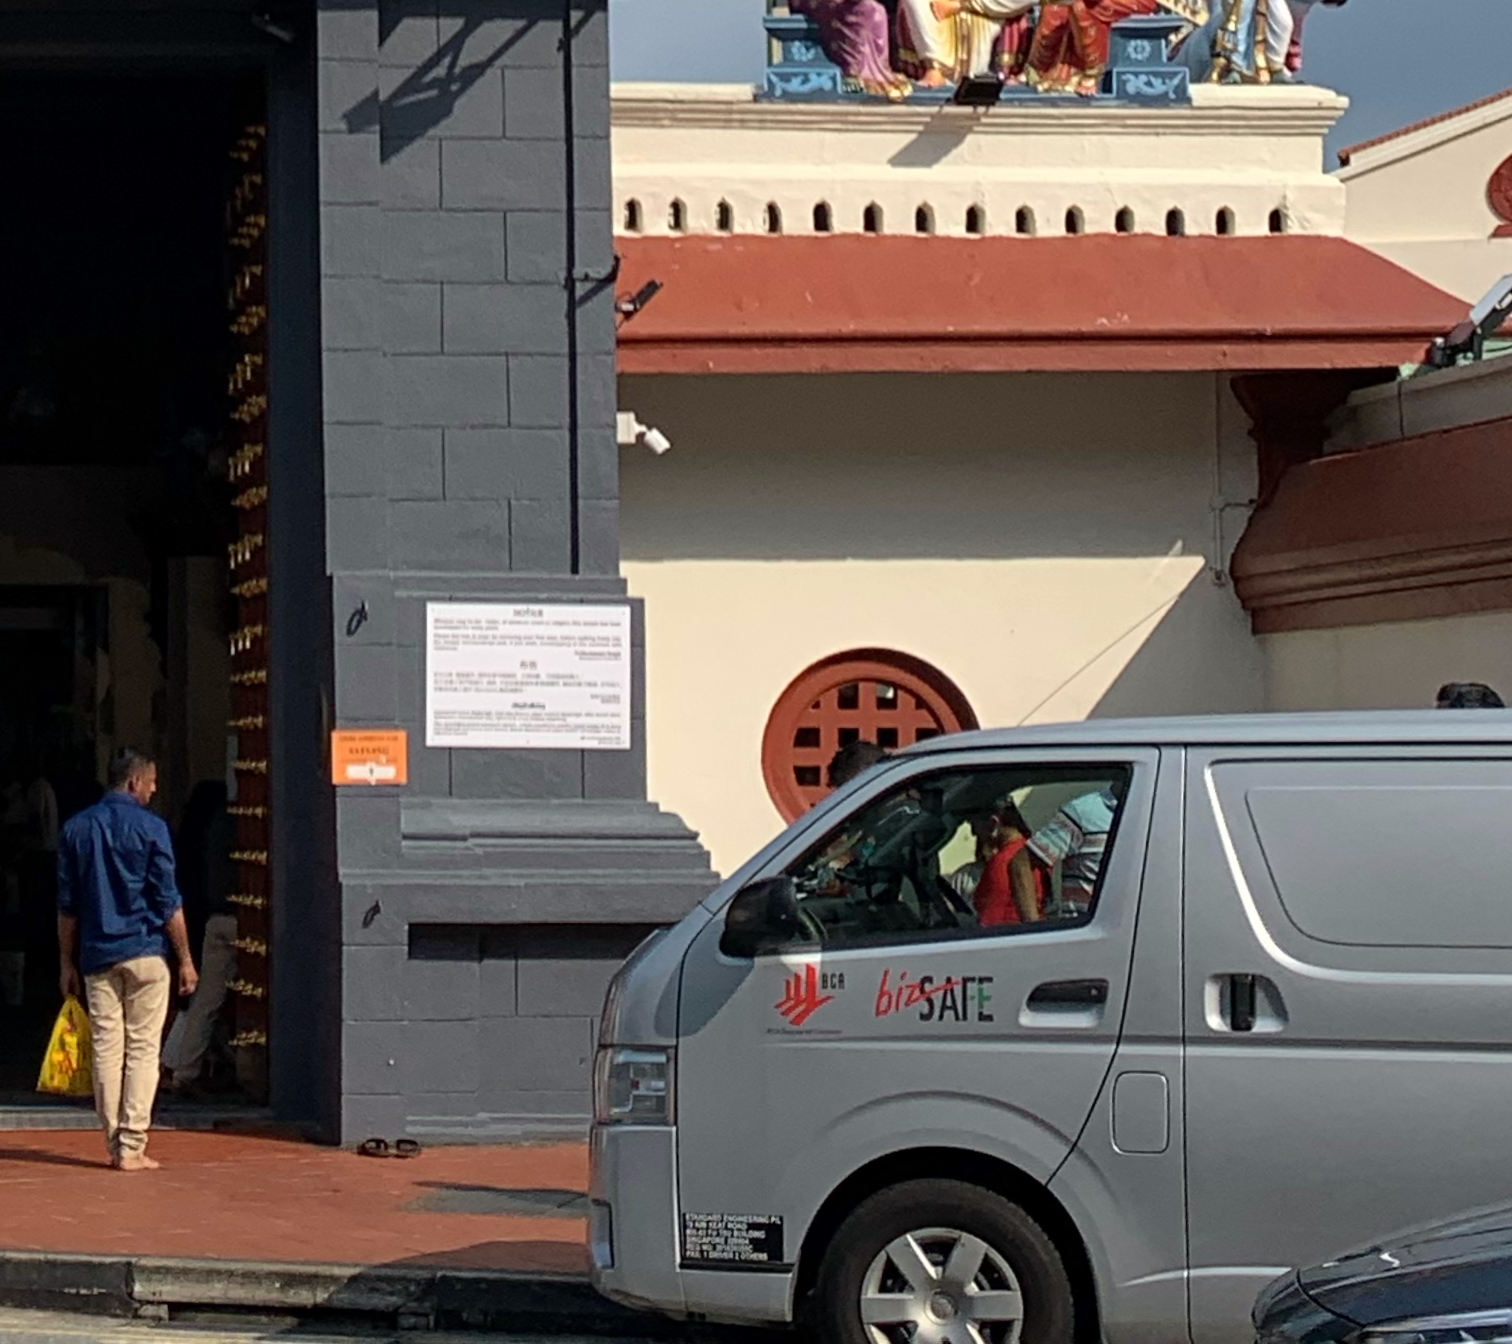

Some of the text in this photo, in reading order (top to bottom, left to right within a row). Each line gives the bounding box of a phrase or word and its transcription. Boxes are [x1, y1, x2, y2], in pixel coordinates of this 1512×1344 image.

[821, 973, 845, 990] BCA
[727, 1222, 748, 1230] ROAD
[733, 1230, 766, 1239] BUILDING
